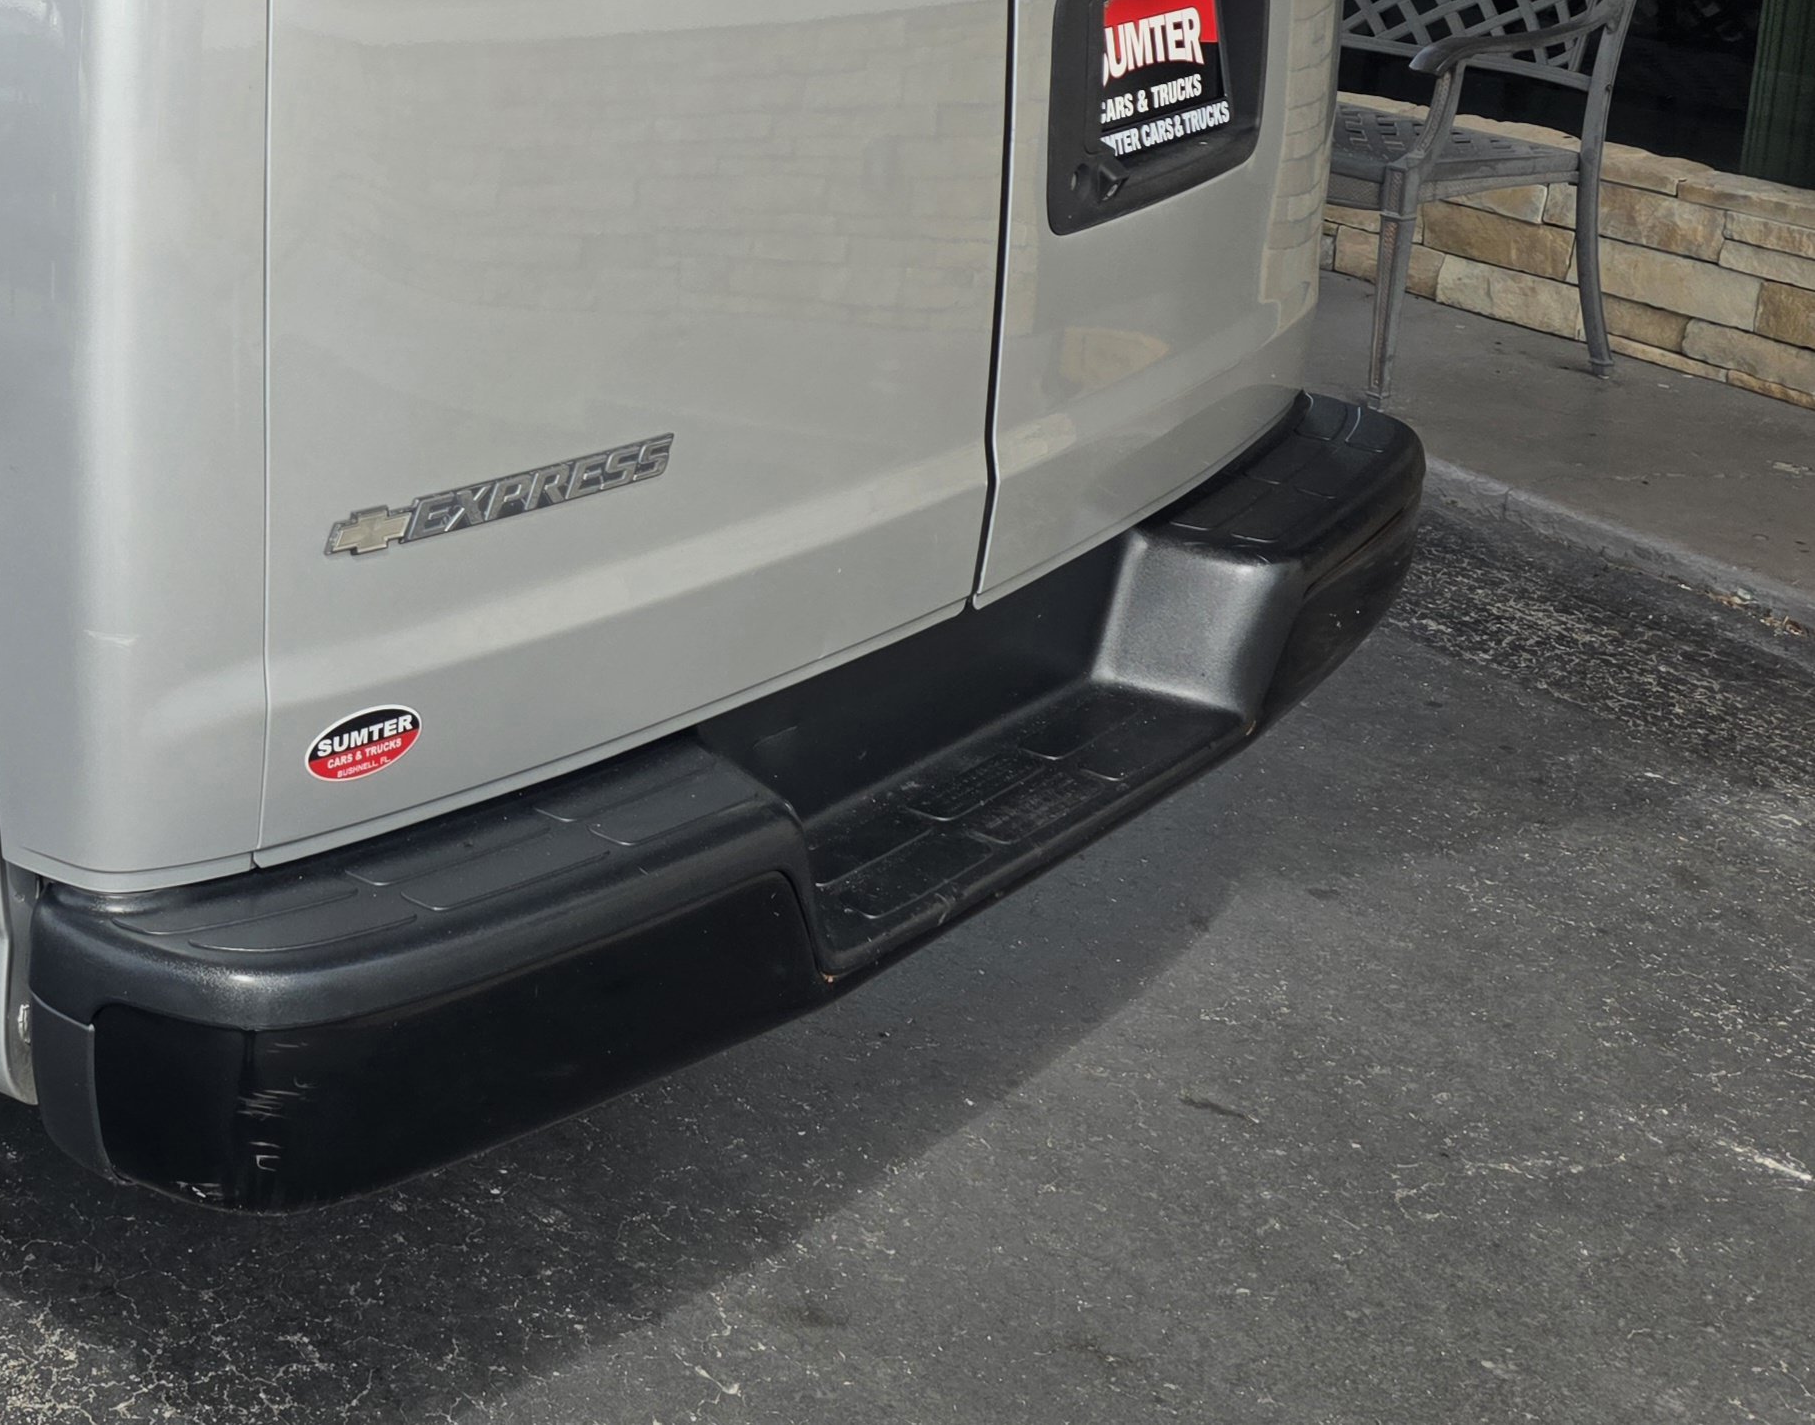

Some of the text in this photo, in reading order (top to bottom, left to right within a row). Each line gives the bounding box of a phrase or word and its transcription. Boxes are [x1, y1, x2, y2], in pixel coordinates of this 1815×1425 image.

[1102, 7, 1205, 87] UMTER
[1136, 89, 1150, 113] &
[1151, 73, 1203, 109] TRUCKS
[407, 432, 674, 543] EXPRESS
[317, 715, 413, 757] SUMTER
[327, 738, 402, 769] CARS & TRUCKS
